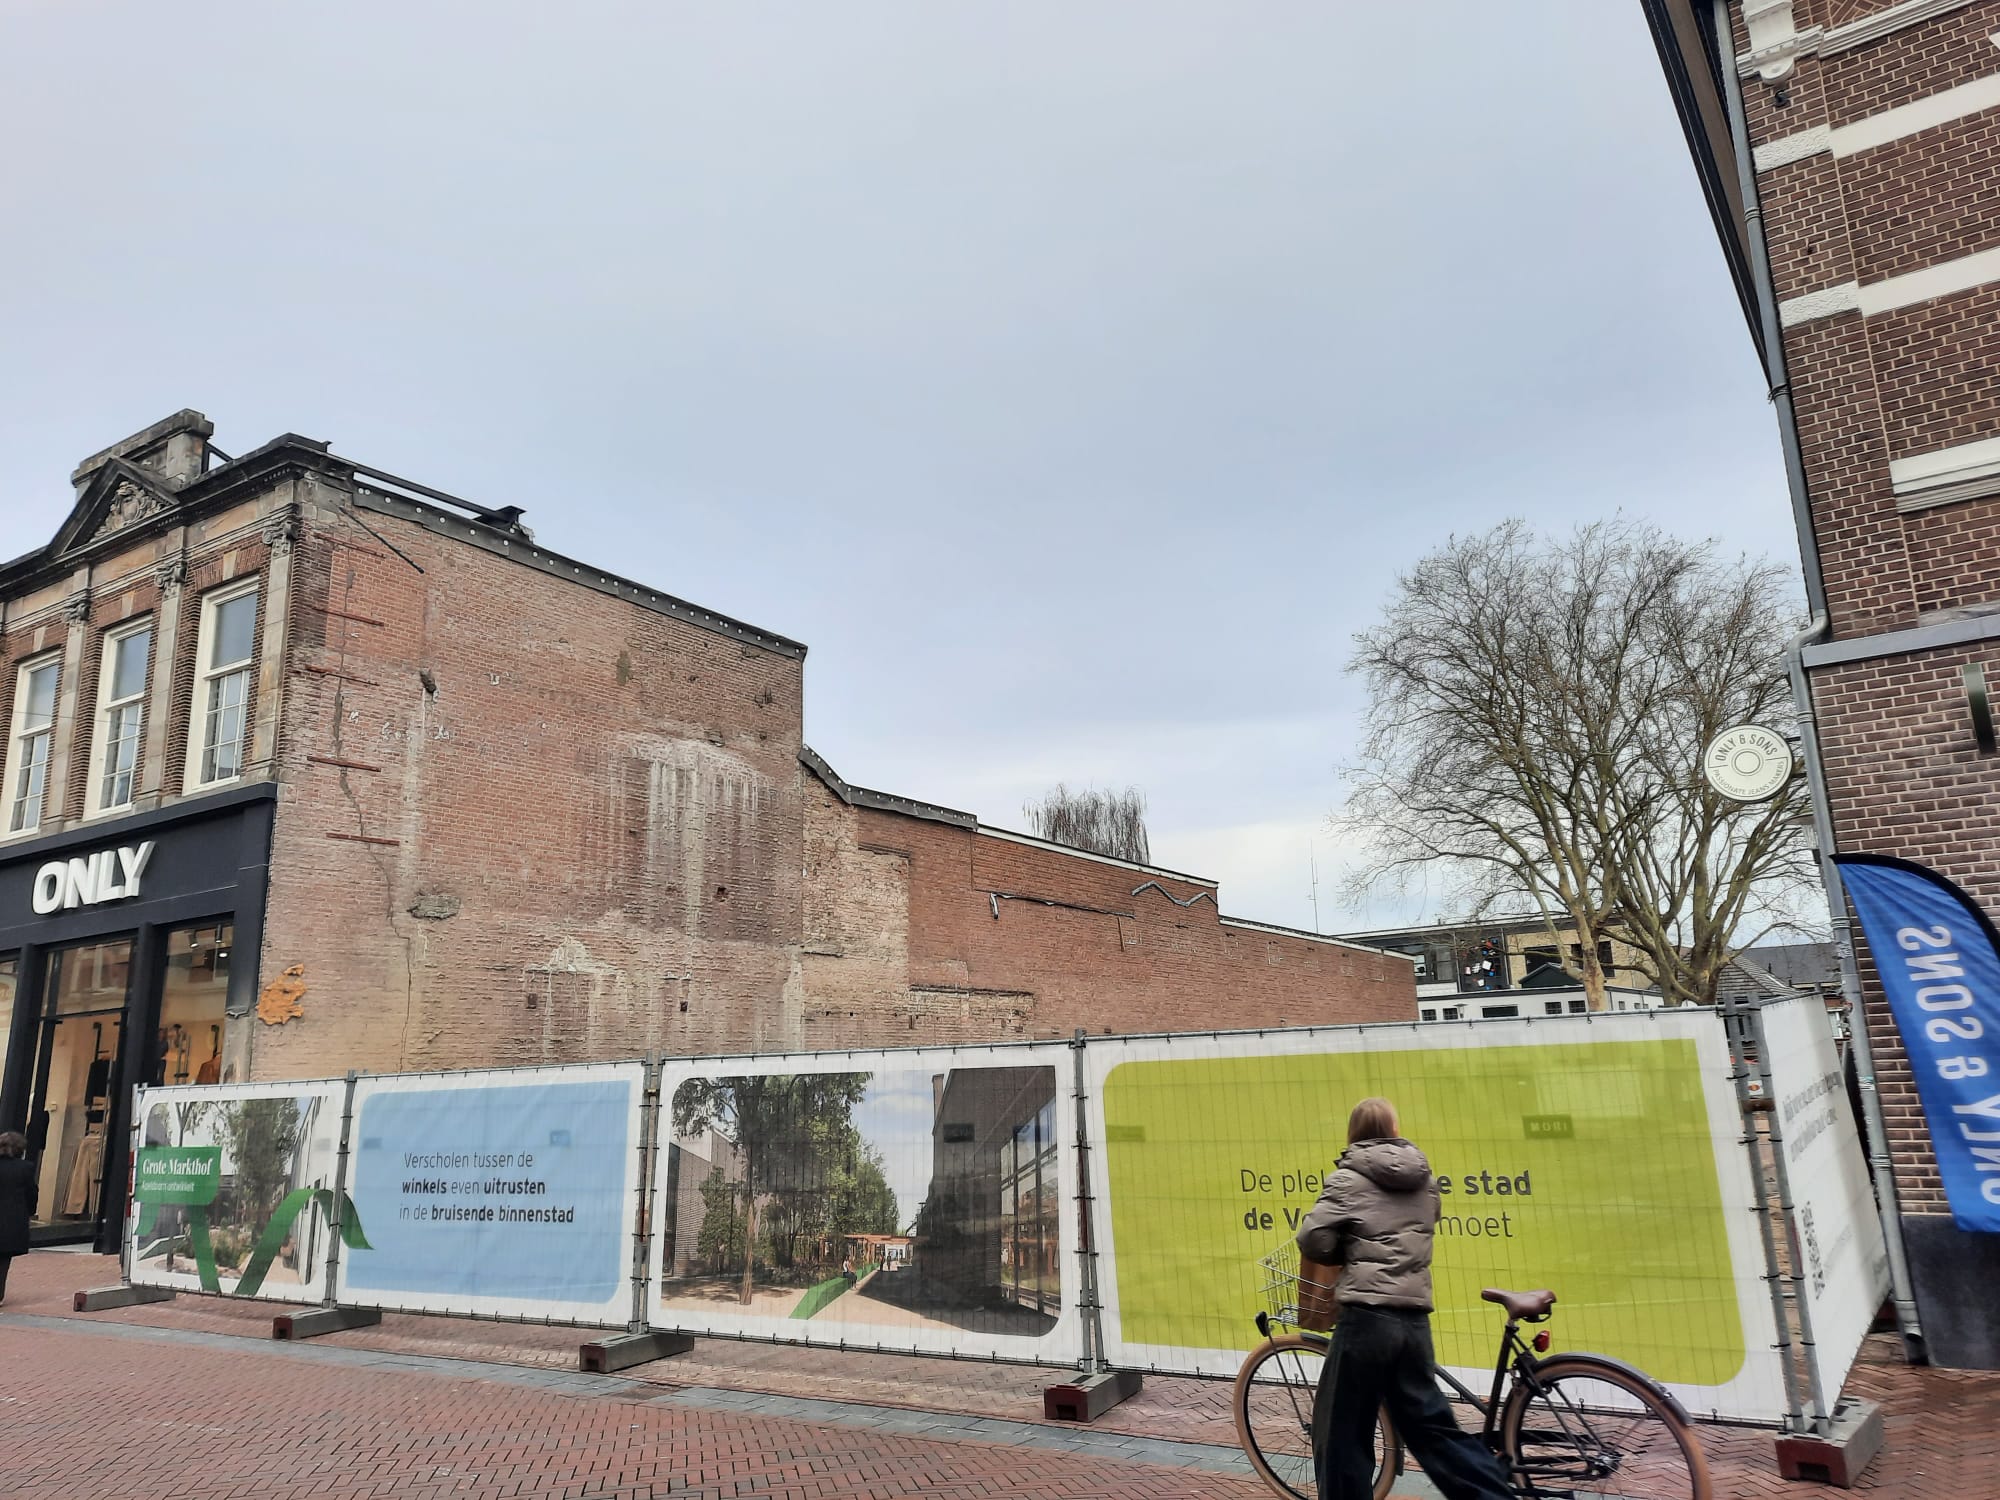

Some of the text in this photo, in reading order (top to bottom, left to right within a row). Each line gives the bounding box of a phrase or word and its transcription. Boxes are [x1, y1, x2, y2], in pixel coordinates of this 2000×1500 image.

[1715, 734, 1778, 761] ONLY & SONS
[32, 841, 156, 915] ONLY
[142, 1157, 214, 1176] Grote Markthof
[404, 1151, 534, 1169] Verscholen tussen de
[402, 1177, 546, 1195] winkels even uitrusten
[1241, 1169, 1272, 1193] De
[1463, 1169, 1531, 1196] stad
[399, 1204, 575, 1223] in de bruisende binnenstad
[1244, 1207, 1273, 1231] de
